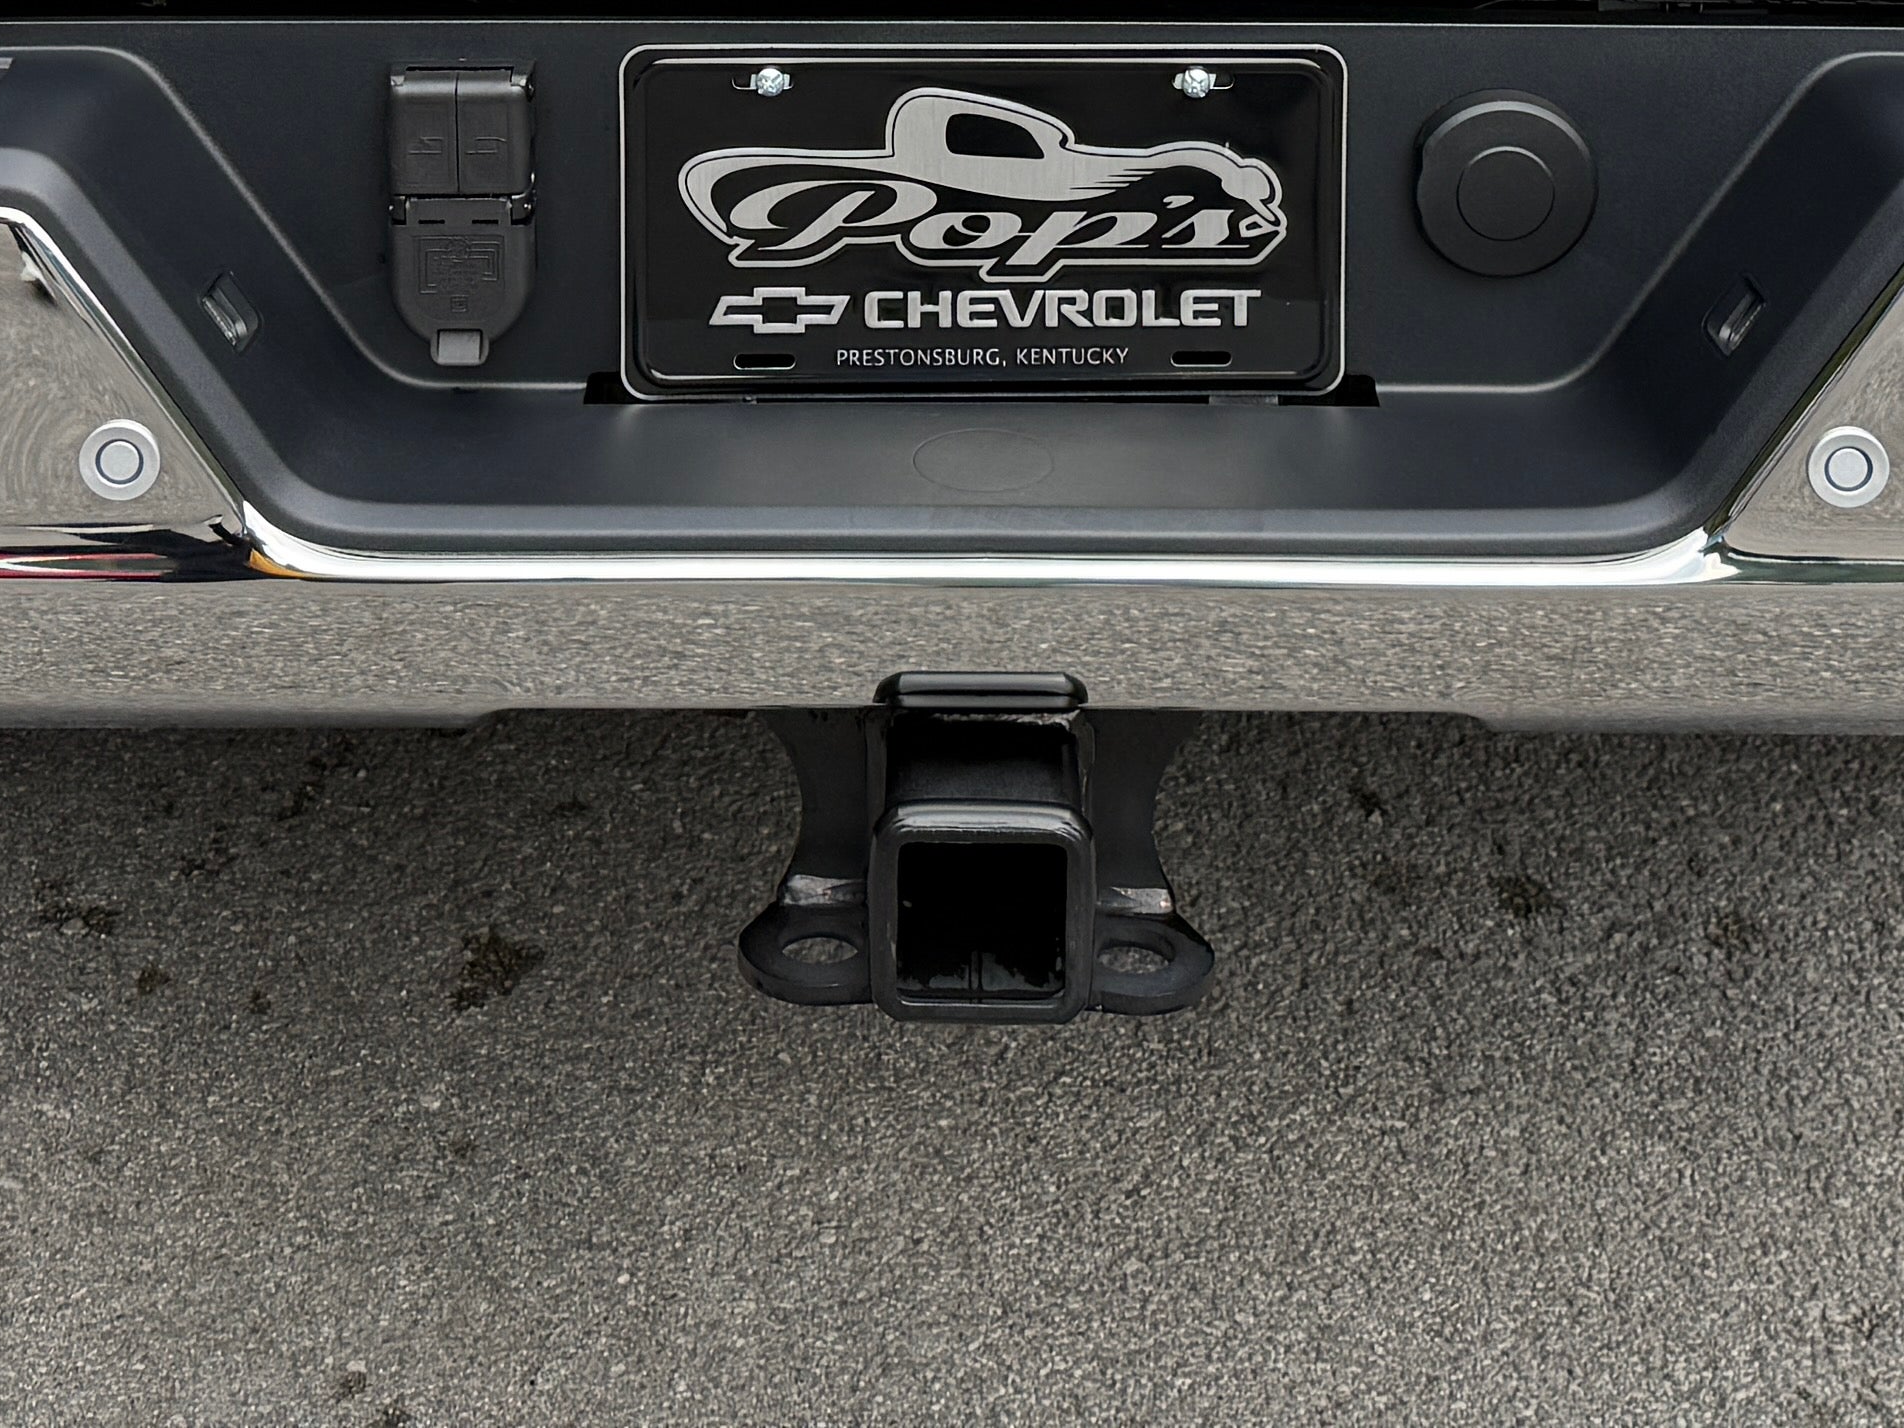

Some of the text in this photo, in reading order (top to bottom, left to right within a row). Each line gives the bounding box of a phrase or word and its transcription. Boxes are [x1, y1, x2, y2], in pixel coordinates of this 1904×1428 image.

[728, 179, 1252, 266] Pop's
[863, 288, 1263, 329] CHEVROLET
[835, 346, 1130, 368] PRESTONSBURG, KENTUCKY
